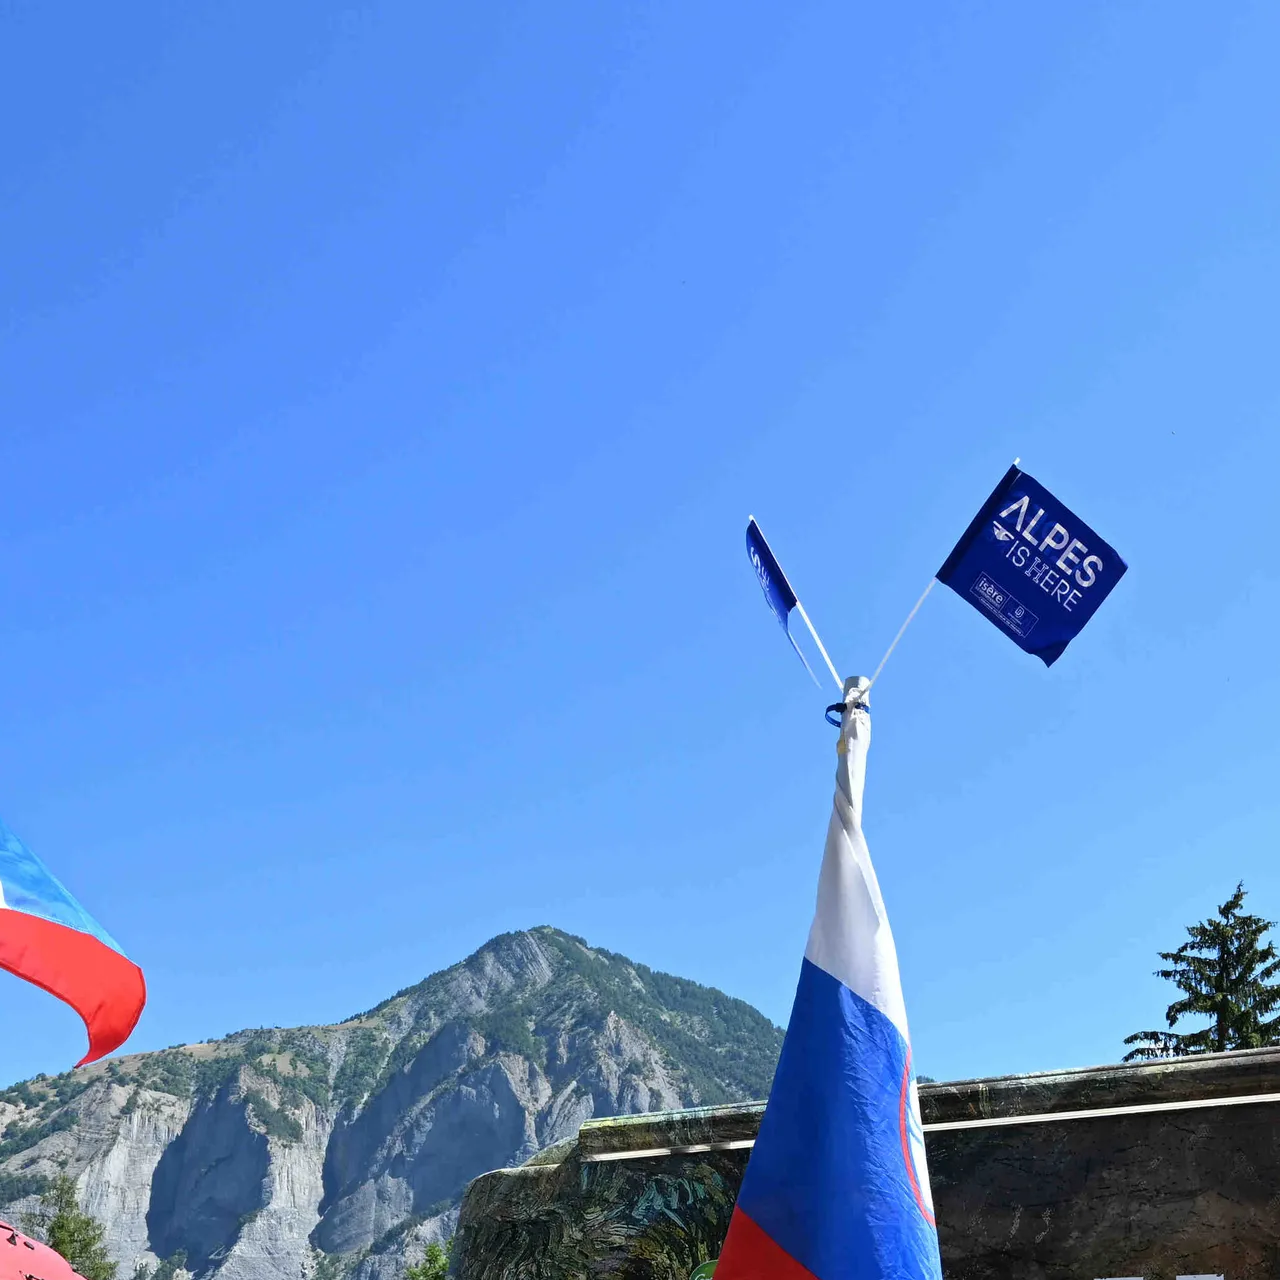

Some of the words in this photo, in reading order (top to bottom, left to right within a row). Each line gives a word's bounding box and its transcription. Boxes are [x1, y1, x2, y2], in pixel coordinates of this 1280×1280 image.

[999, 495, 1104, 588] ALPES
[1005, 541, 1030, 567] IS
[1025, 557, 1082, 612] HERE
